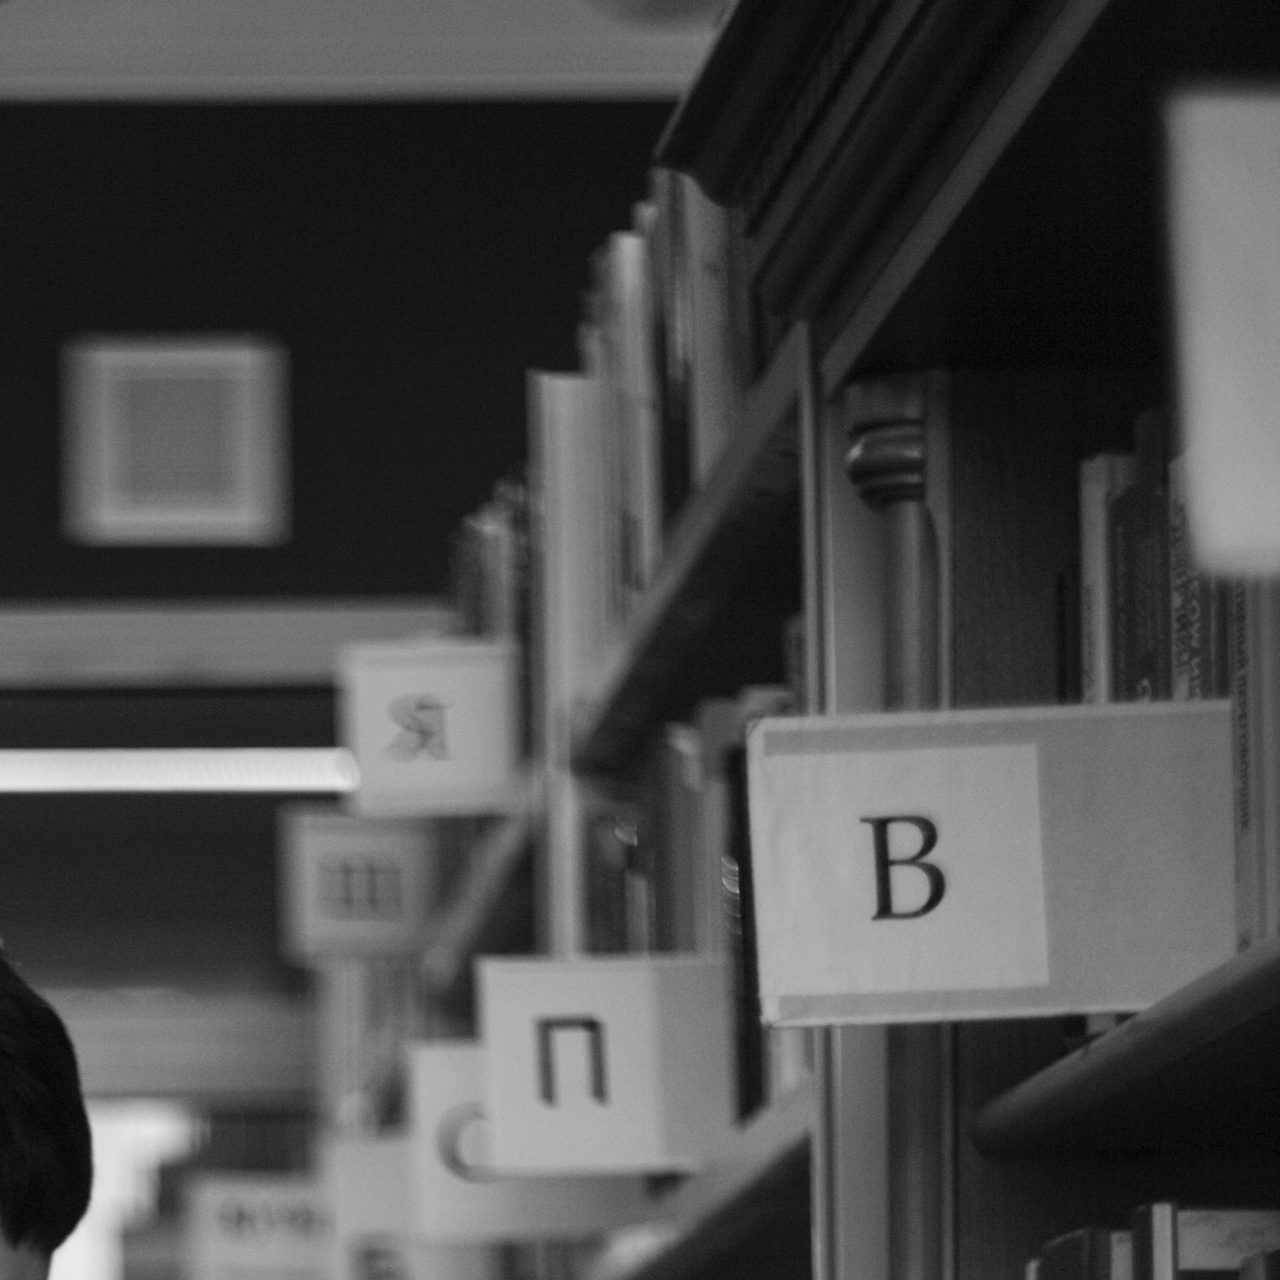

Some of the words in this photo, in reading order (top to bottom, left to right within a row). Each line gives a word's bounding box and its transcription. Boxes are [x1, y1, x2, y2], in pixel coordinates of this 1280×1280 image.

[386, 692, 451, 762] Я
[859, 814, 947, 921] В
[532, 1012, 611, 1109] П
